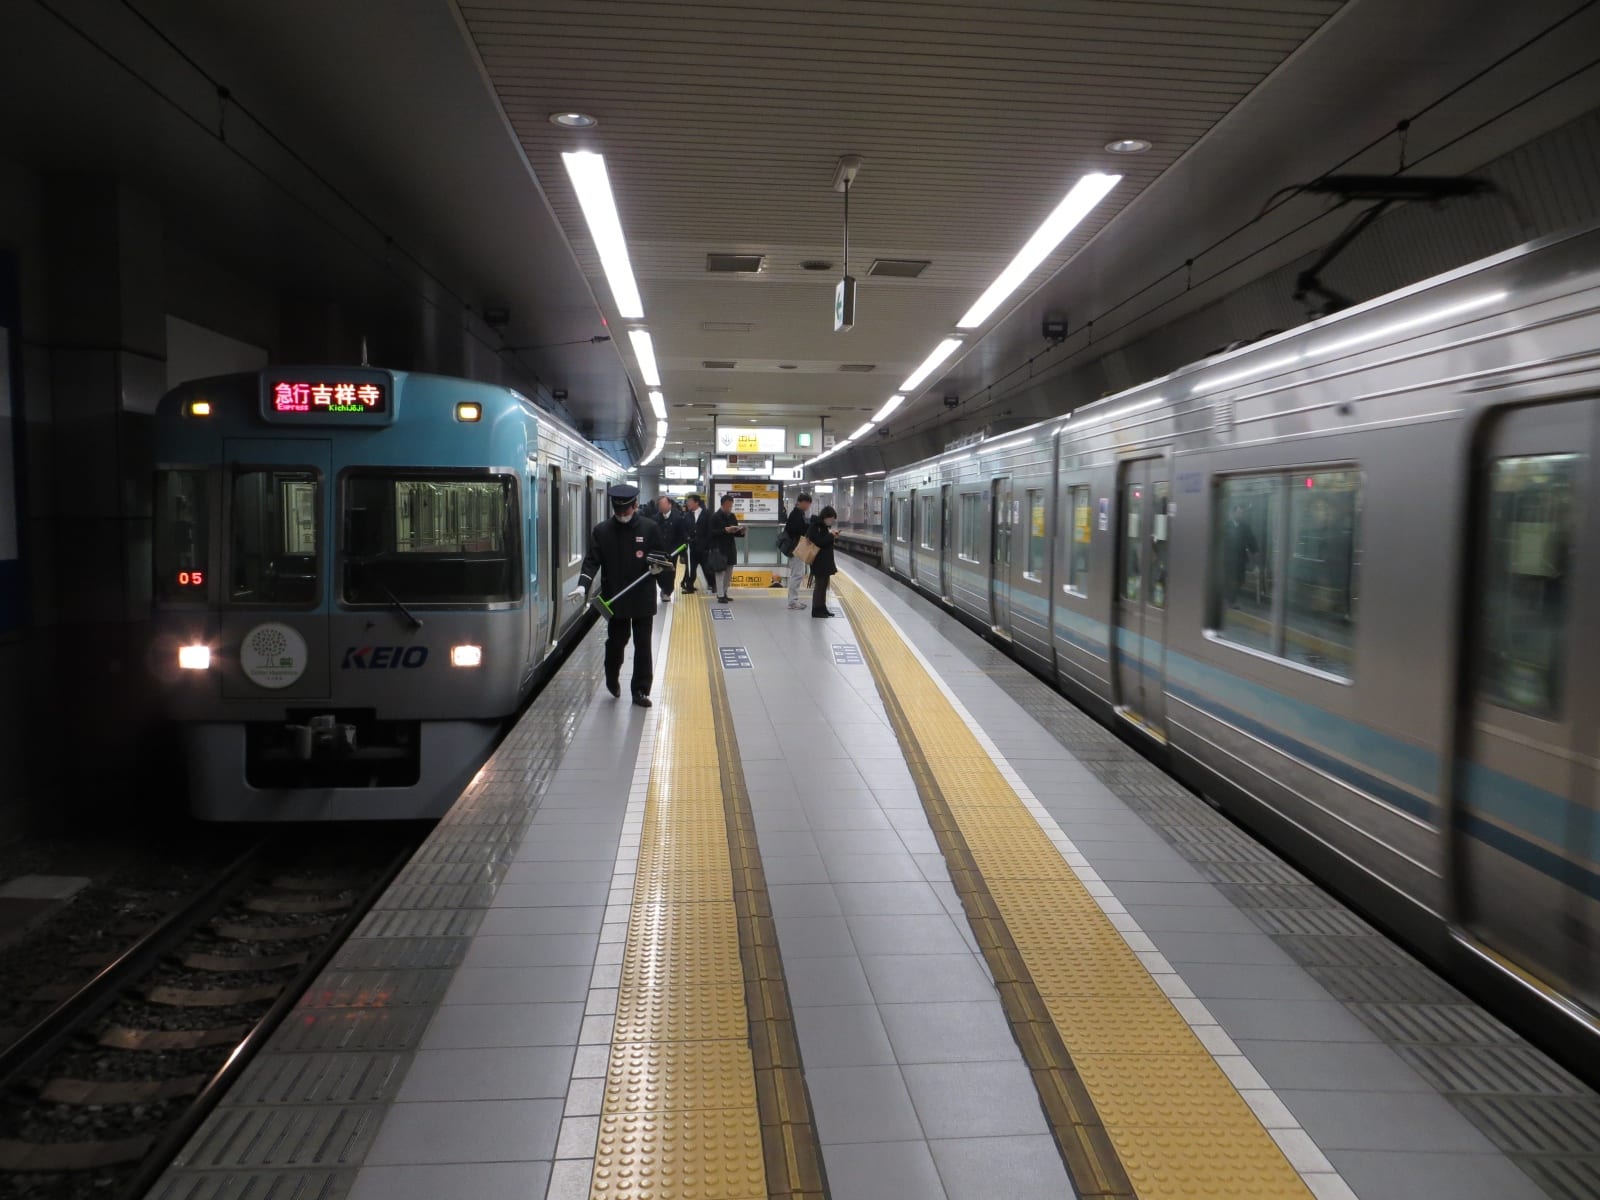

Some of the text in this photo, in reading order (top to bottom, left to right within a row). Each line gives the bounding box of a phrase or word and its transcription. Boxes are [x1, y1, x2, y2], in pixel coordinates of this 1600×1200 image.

[276, 382, 380, 406] 急行 吉祥寺
[179, 572, 202, 585] 05
[341, 646, 429, 669] KEIO
